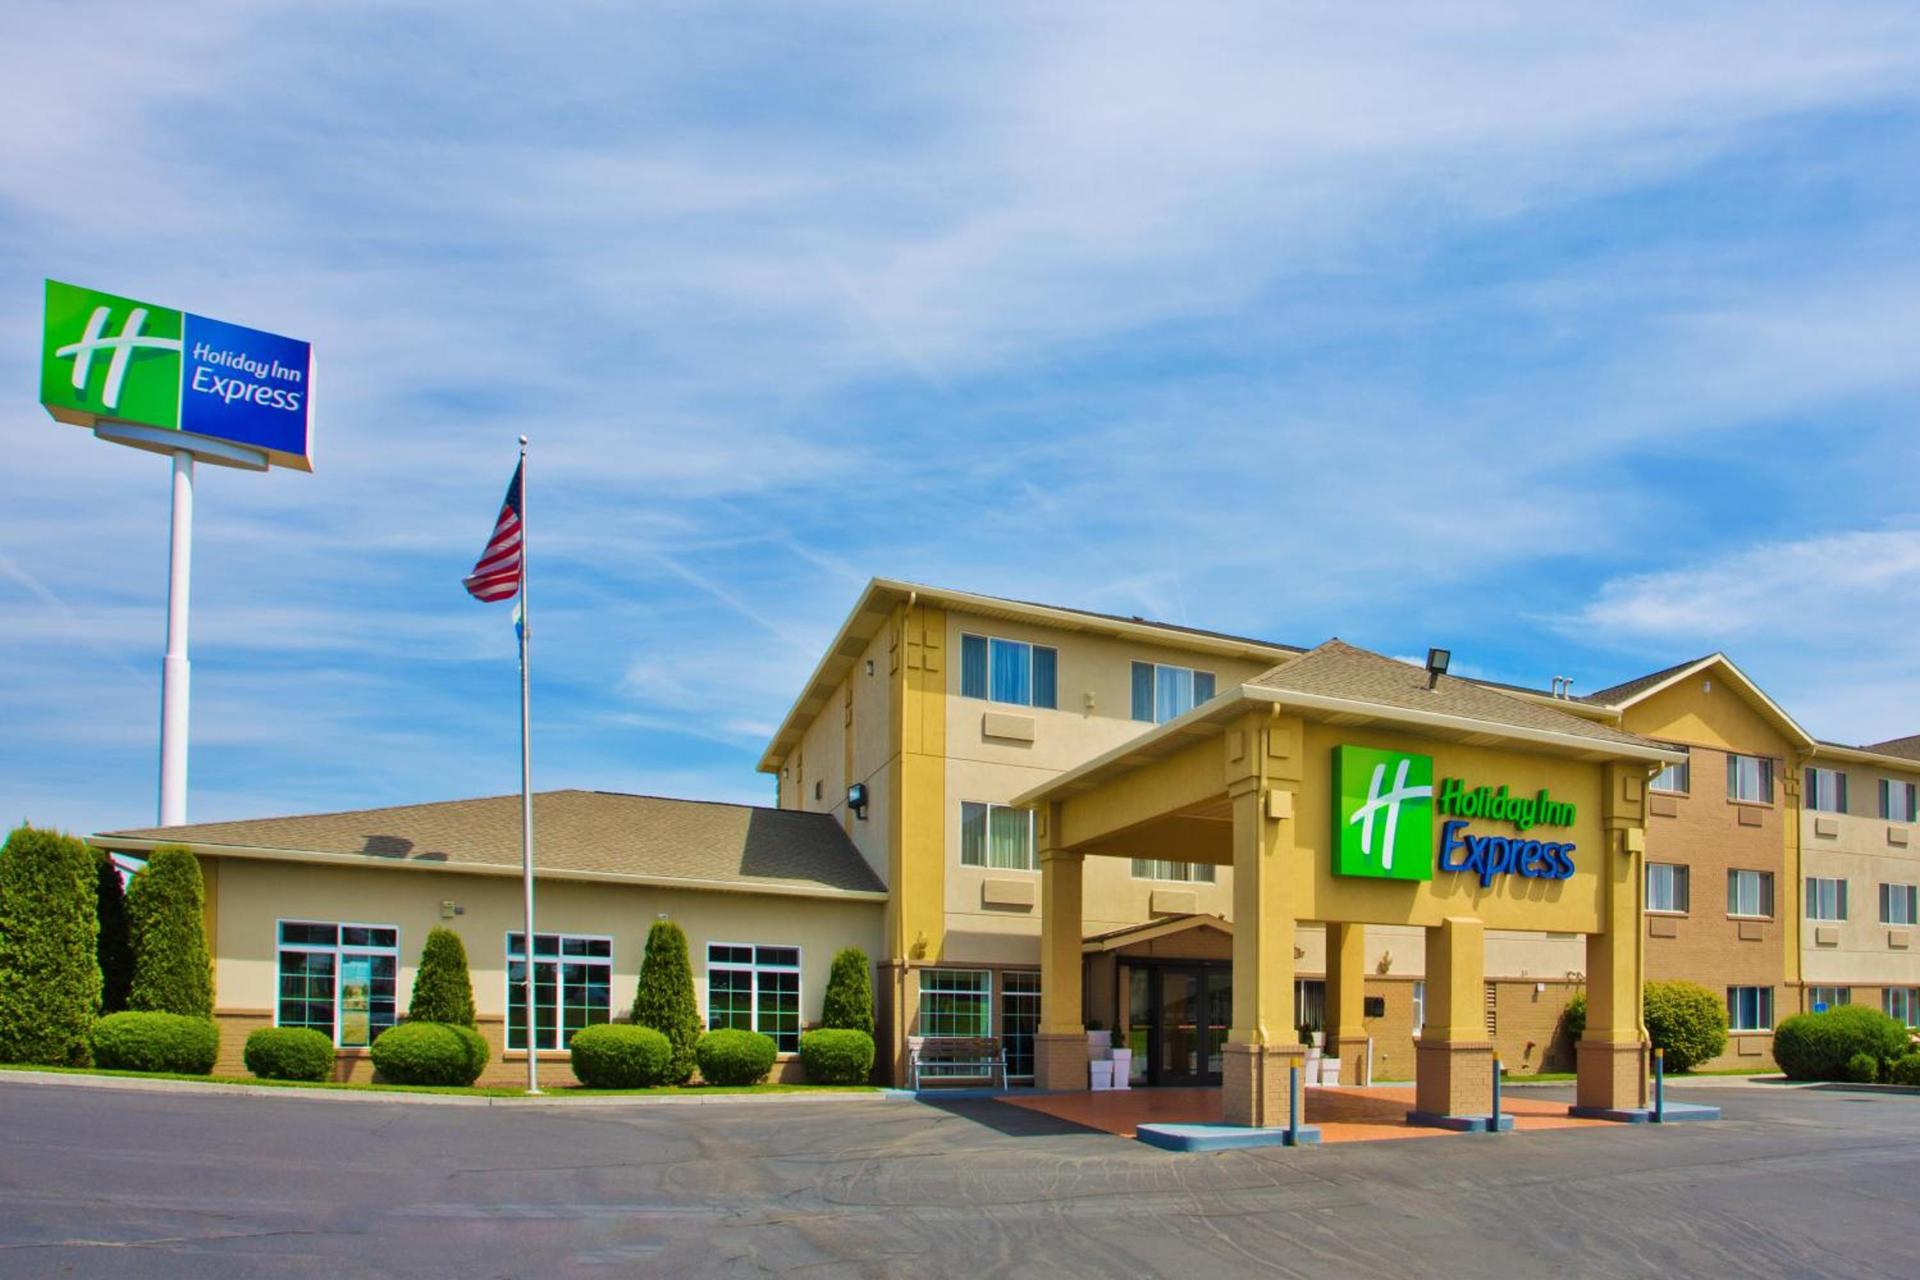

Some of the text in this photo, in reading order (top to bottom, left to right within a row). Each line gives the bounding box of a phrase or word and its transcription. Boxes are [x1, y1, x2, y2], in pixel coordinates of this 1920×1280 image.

[193, 341, 302, 383] Holiday Inn
[192, 366, 300, 411] Express
[1438, 777, 1576, 831] Holiday Inn
[1438, 820, 1576, 888] Express
